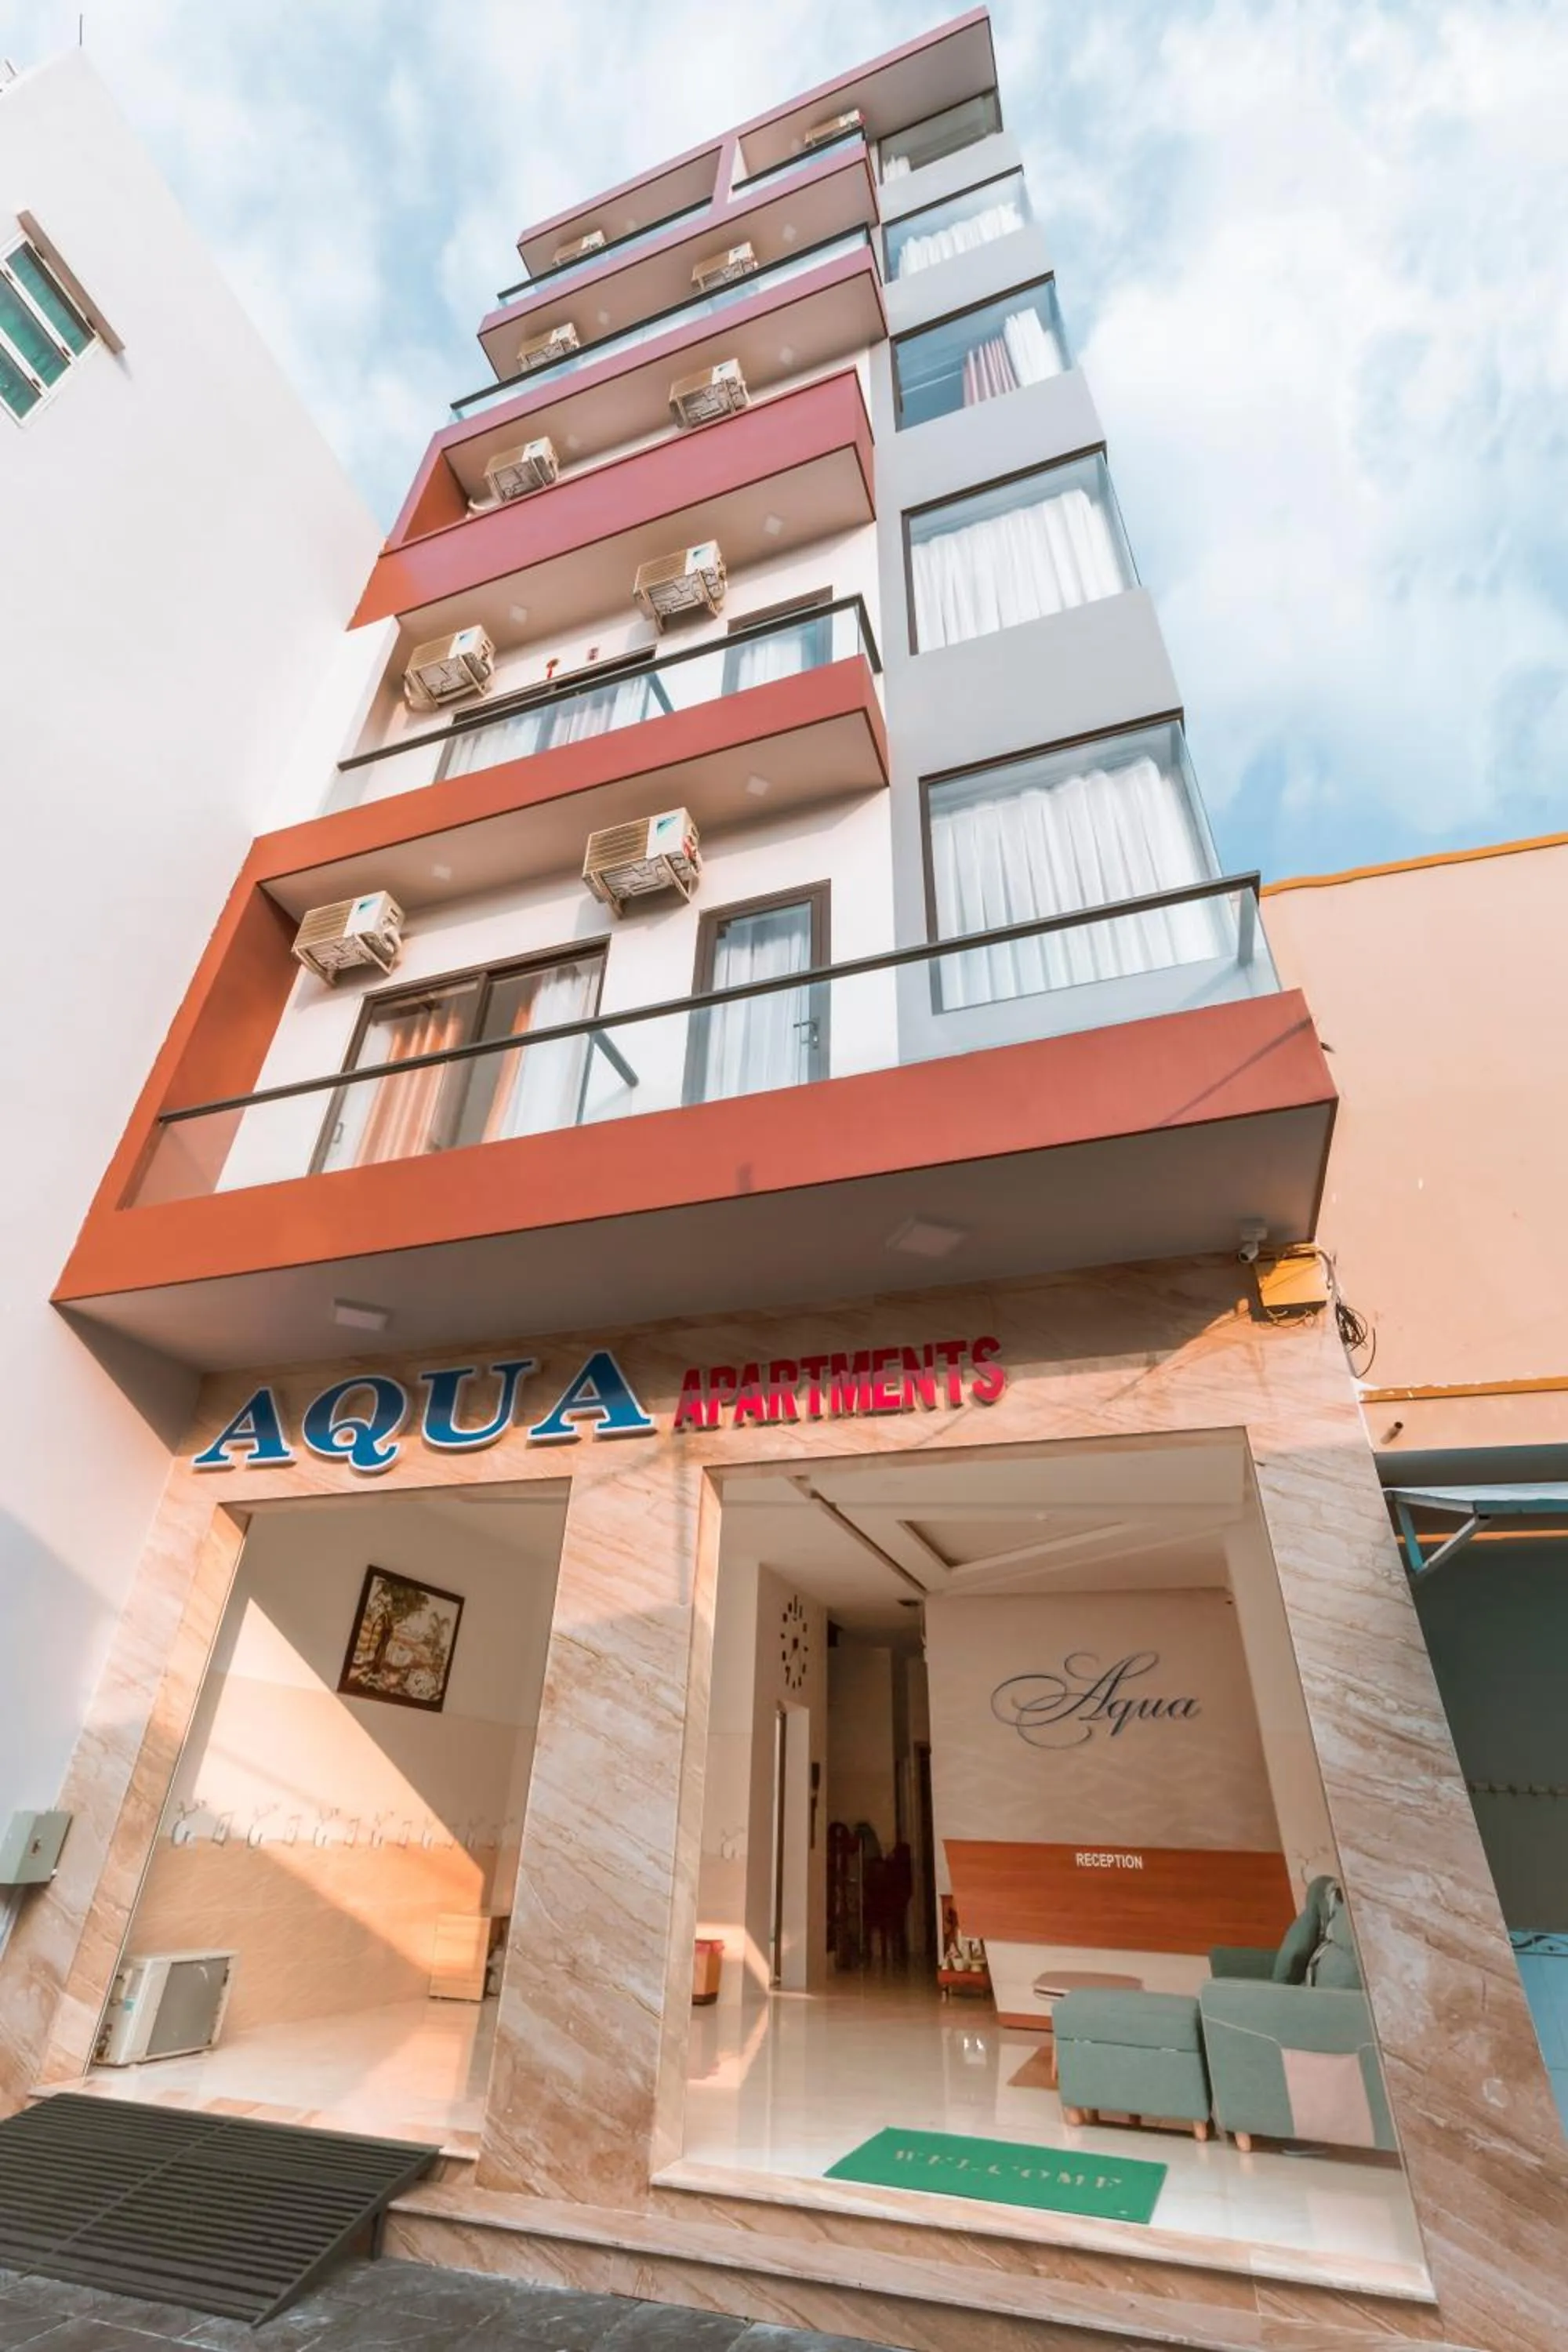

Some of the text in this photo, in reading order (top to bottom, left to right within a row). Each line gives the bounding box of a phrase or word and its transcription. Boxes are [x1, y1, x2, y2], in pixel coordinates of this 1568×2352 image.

[192, 1336, 1004, 1472] AQUA APARTMENTS
[990, 1651, 1200, 1749] Aqua
[1076, 1853, 1143, 1870] RECEPTION
